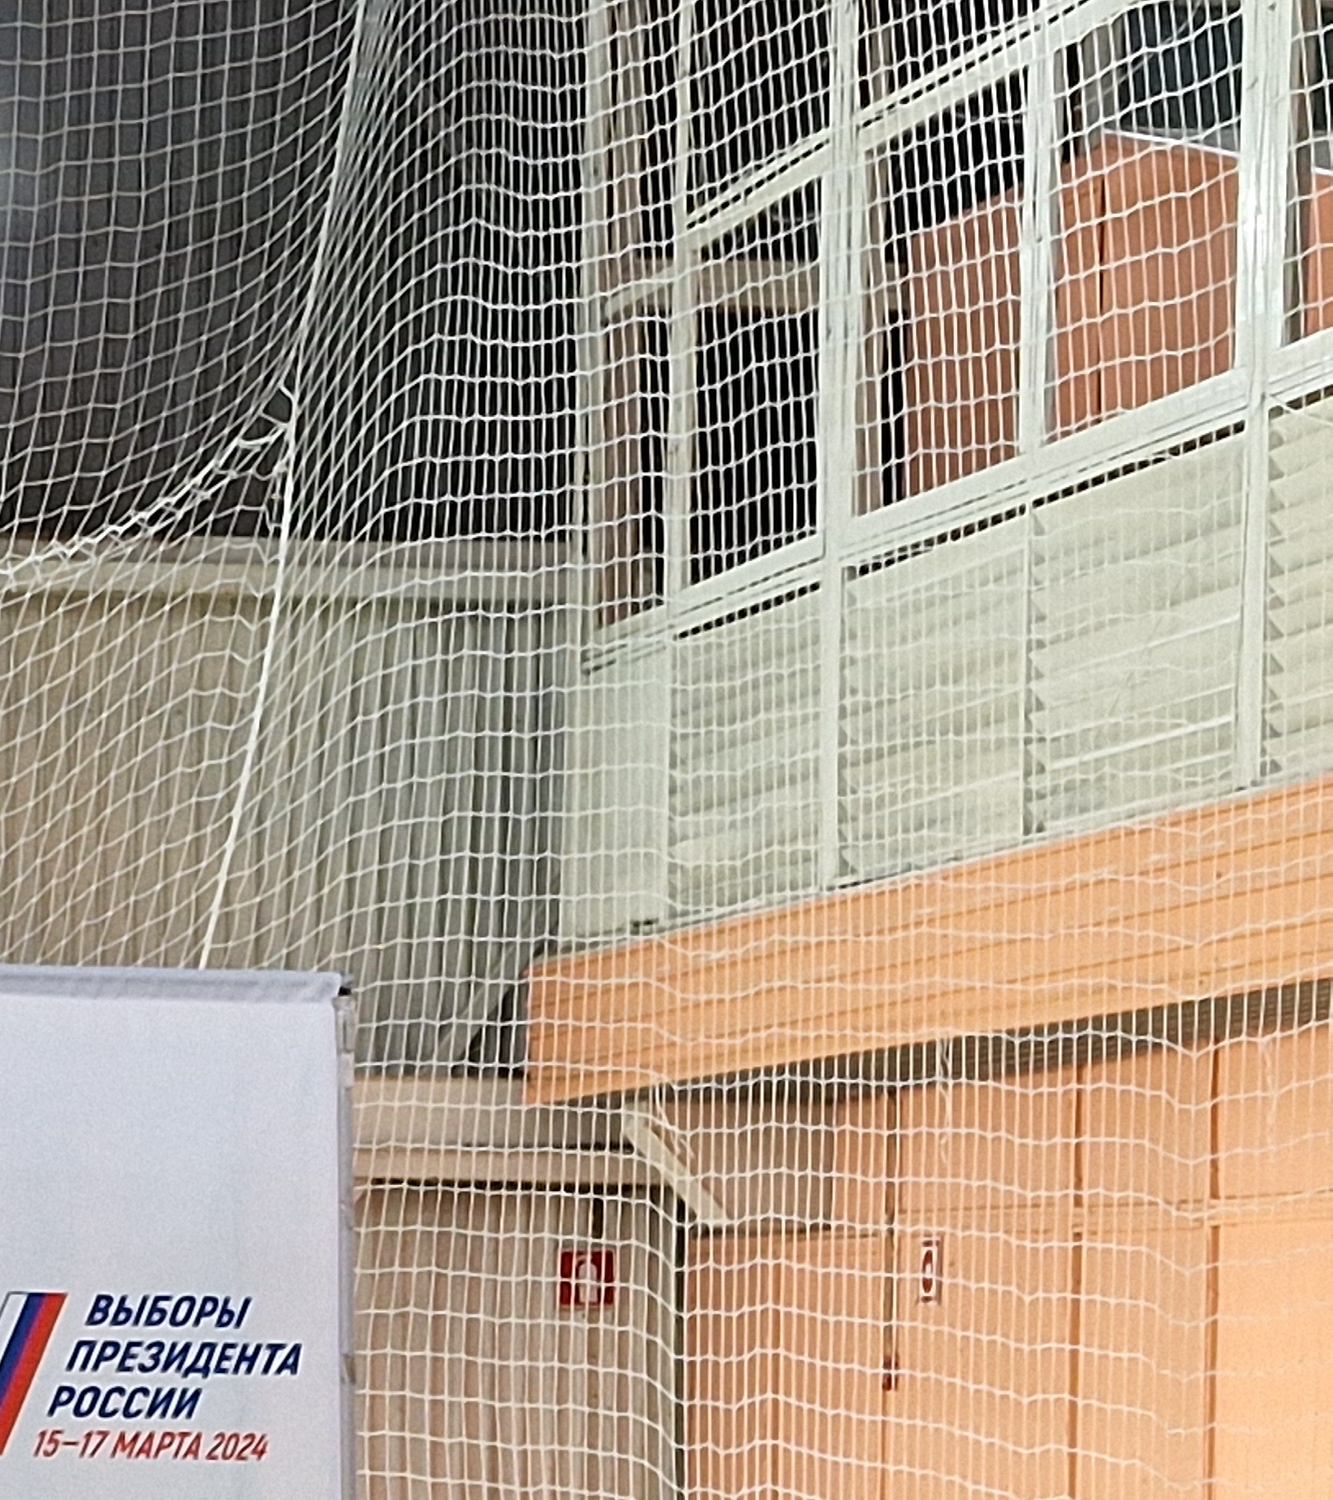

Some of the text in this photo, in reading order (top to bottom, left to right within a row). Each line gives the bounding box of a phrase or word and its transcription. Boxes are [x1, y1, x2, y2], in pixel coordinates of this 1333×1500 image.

[85, 1294, 251, 1329] ВЫБОРЫ
[66, 1341, 302, 1379] ПРЕЗИДЕНТА
[48, 1386, 202, 1419] РОССИИ
[111, 1431, 204, 1460] МАРТА
[206, 1433, 268, 1461] 2024
